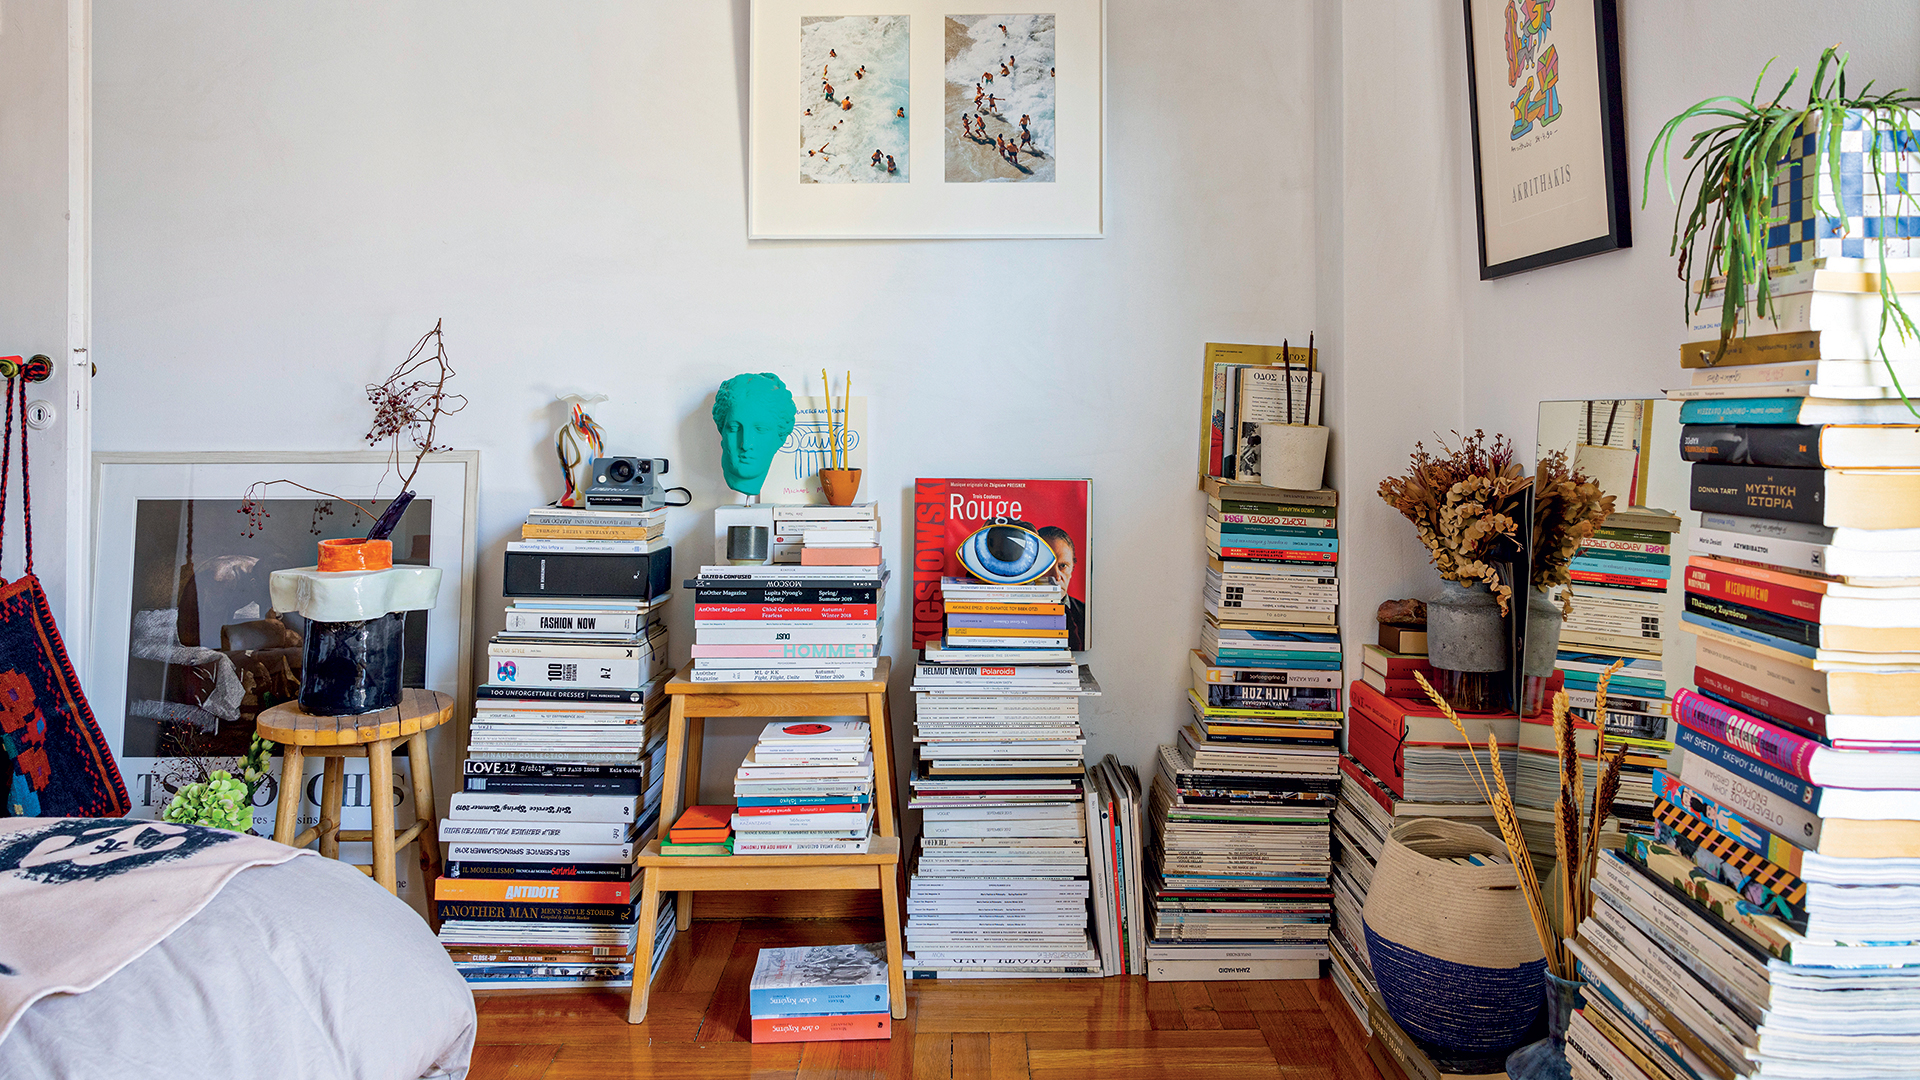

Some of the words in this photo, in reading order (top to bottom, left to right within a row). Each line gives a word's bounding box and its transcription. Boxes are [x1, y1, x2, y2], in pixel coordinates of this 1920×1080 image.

[1512, 164, 1572, 203] AKRITHAKIS
[1276, 353, 1306, 361] ΖΓΟΣ
[1254, 372, 1278, 382] ΟΔΟΣ
[1698, 486, 1719, 494] DONNA
[1745, 484, 1796, 496] ΜΥΣΤΙΚΗ
[950, 494, 1022, 525] Rouge
[1747, 496, 1794, 510] ΙΣΤΟΡΙΑ
[1247, 516, 1280, 524] ΟΡΓΟΥΕΛ
[1282, 517, 1307, 526] ΤΖΩΡΤΖ
[1733, 542, 1768, 554] ΑΣΥΜΒΙΒΑΣΤΟΙ
[1725, 580, 1768, 602] ΜΙΣΟΨΗΜΕΝΟ
[1692, 598, 1717, 613] Πλάτωνος
[1718, 604, 1748, 620] Συμπόσιον
[540, 616, 573, 629] FASHION
[577, 618, 596, 629] NOW
[783, 644, 872, 657] HOMME+
[548, 664, 562, 681] 100
[601, 668, 611, 679] A-Z
[1242, 687, 1263, 700] ΖΩΗ
[1266, 689, 1289, 700] ΛΙΓΗ
[1726, 714, 1764, 757] GAME
[1682, 731, 1694, 744] JAY
[1694, 735, 1719, 755] SHETTY
[467, 763, 500, 773] LOVE
[1723, 750, 1749, 769] ΣΚΕΨΟΥ
[1749, 761, 1763, 774] ΣΑΝ
[1763, 769, 1799, 794] ΜΟΝΑΧΟΣ
[1704, 768, 1730, 786] GRISHAM
[1712, 782, 1728, 796] JOHN
[1731, 780, 1768, 806] ΕΝΟΡΚΟΣ
[529, 806, 555, 814] Service
[556, 806, 572, 814] Self
[1729, 790, 1772, 821] ΤΕΛΕΥΤΑΙΟΣ
[1776, 814, 1784, 826] Ο
[551, 866, 577, 876] Sartoriale
[1608, 858, 1620, 869] VOGUE
[1618, 866, 1631, 876] HELLAS
[505, 886, 560, 899] ANTIDOTE
[441, 905, 505, 918] ANOTHER
[509, 907, 539, 918] MAN
[1594, 929, 1606, 940] VOGUE
[1604, 938, 1618, 950] HELLAS
[1580, 964, 1601, 988] HERO
[770, 997, 799, 1005] Κιχώτης
[1595, 1019, 1607, 1032] VOGUE
[1605, 1029, 1620, 1043] HELLAS
[1567, 1036, 1582, 1053] DAZED
